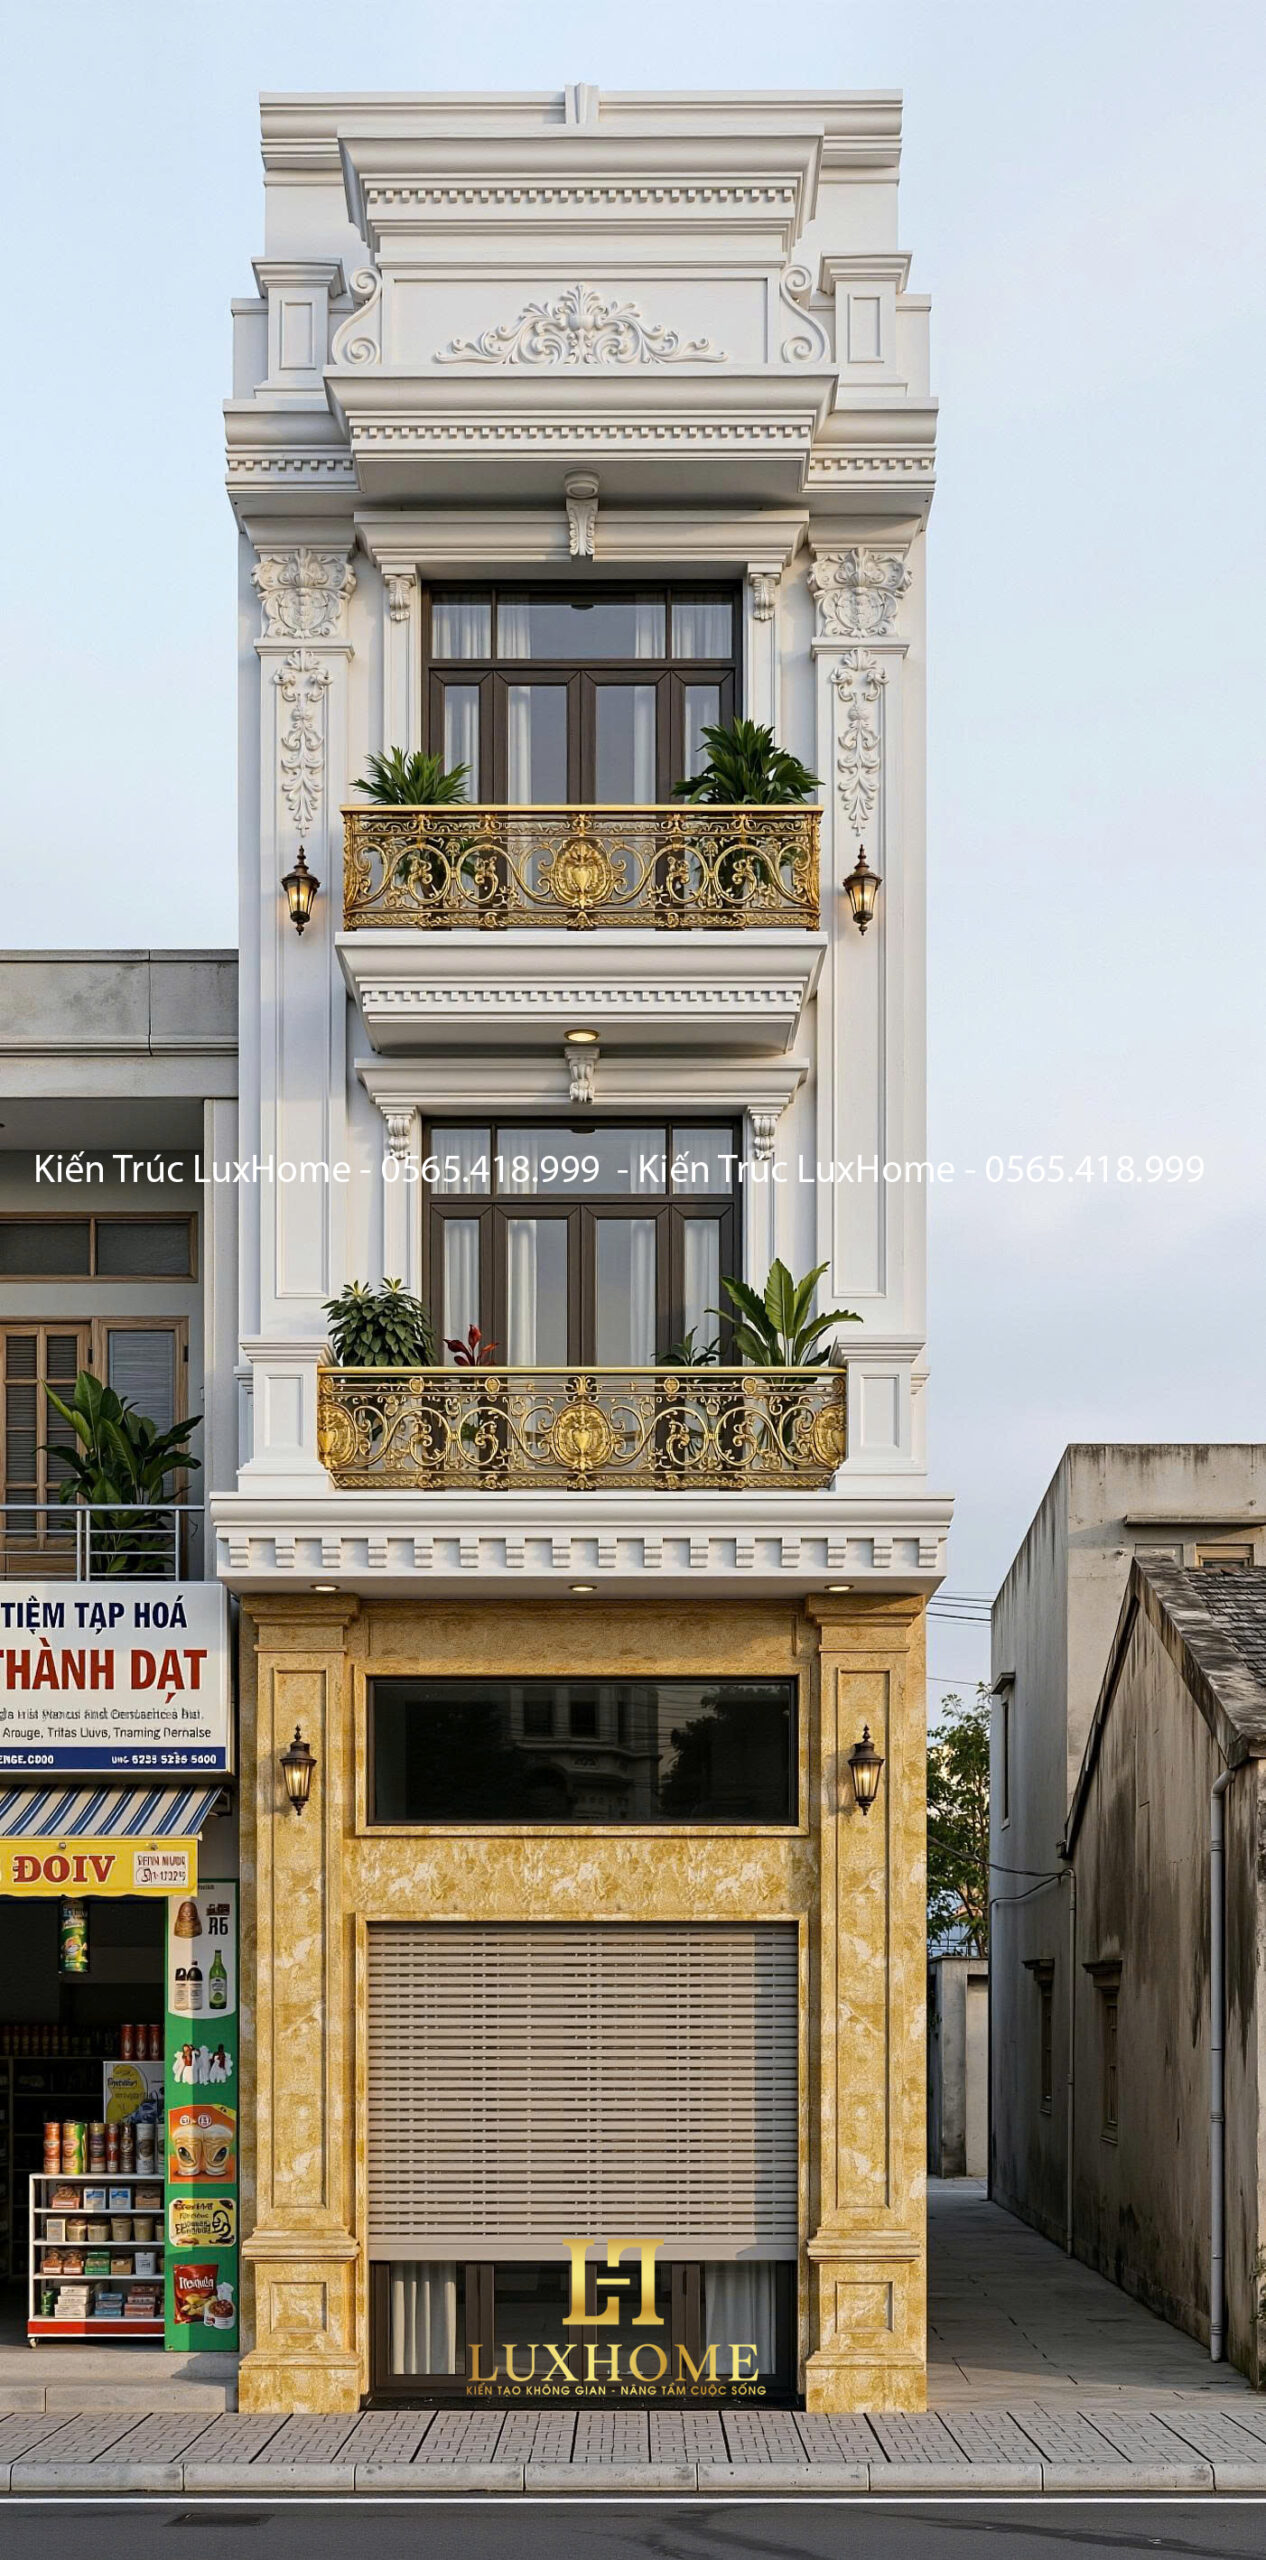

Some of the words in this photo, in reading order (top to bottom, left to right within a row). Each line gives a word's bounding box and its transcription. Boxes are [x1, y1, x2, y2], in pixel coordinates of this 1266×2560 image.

[74, 1602, 125, 1635] TẠP
[134, 1594, 188, 1629] HOÁ
[0, 1637, 115, 1690] HÀNH
